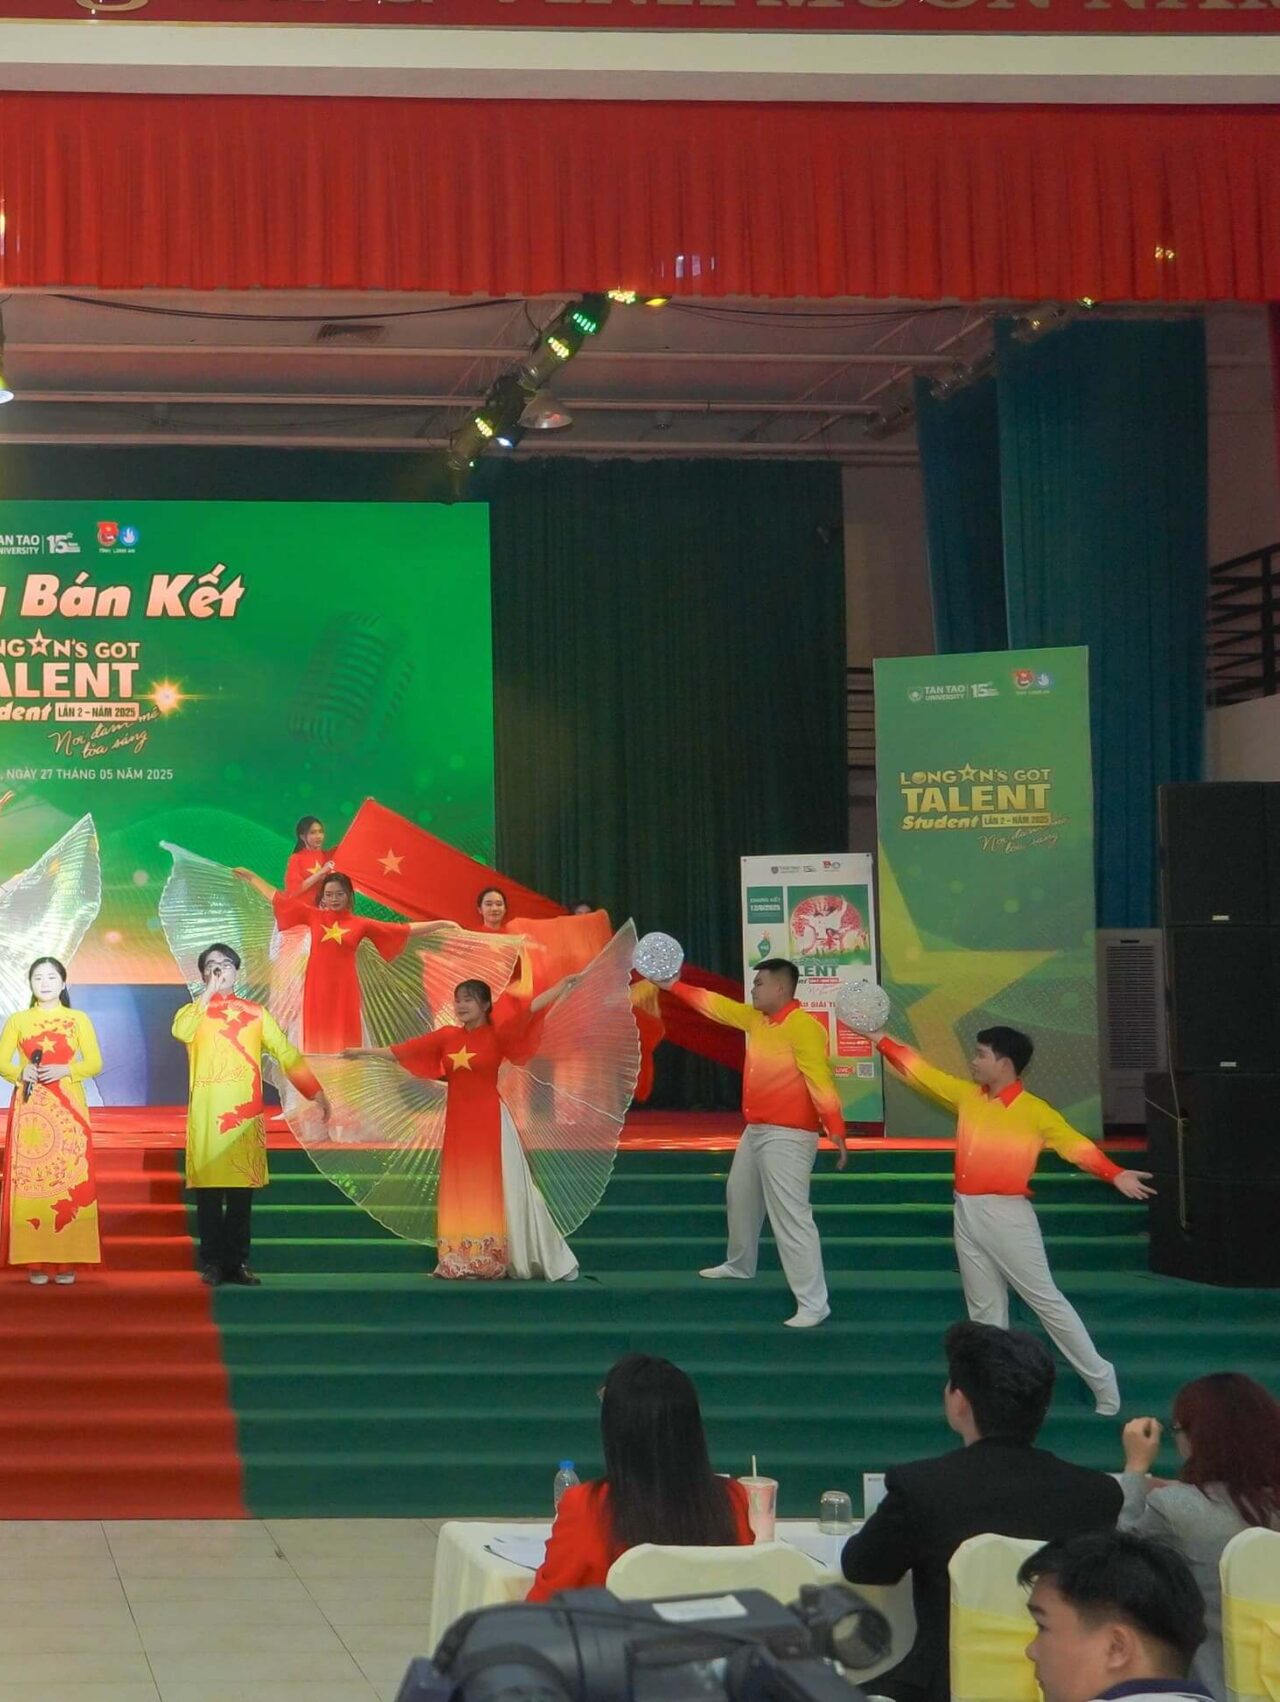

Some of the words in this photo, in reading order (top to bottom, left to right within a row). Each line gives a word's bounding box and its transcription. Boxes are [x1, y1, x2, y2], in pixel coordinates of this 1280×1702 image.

[17, 534, 40, 546] TAO
[20, 571, 132, 618] Bán
[145, 563, 246, 618] Kết
[94, 642, 140, 659] GOT
[924, 685, 945, 695] TAN
[945, 684, 966, 694] TAO
[77, 707, 83, 718] 2
[114, 707, 136, 718] 2025
[6, 766, 37, 780] NGÀY
[40, 768, 53, 780] 27
[55, 766, 97, 780] THÁNG
[99, 768, 114, 780] 05
[116, 766, 144, 780] NĂM
[146, 768, 174, 780] 2025
[1013, 768, 1052, 783] GOT
[901, 783, 1052, 814] TALENT
[901, 814, 980, 831] Student
